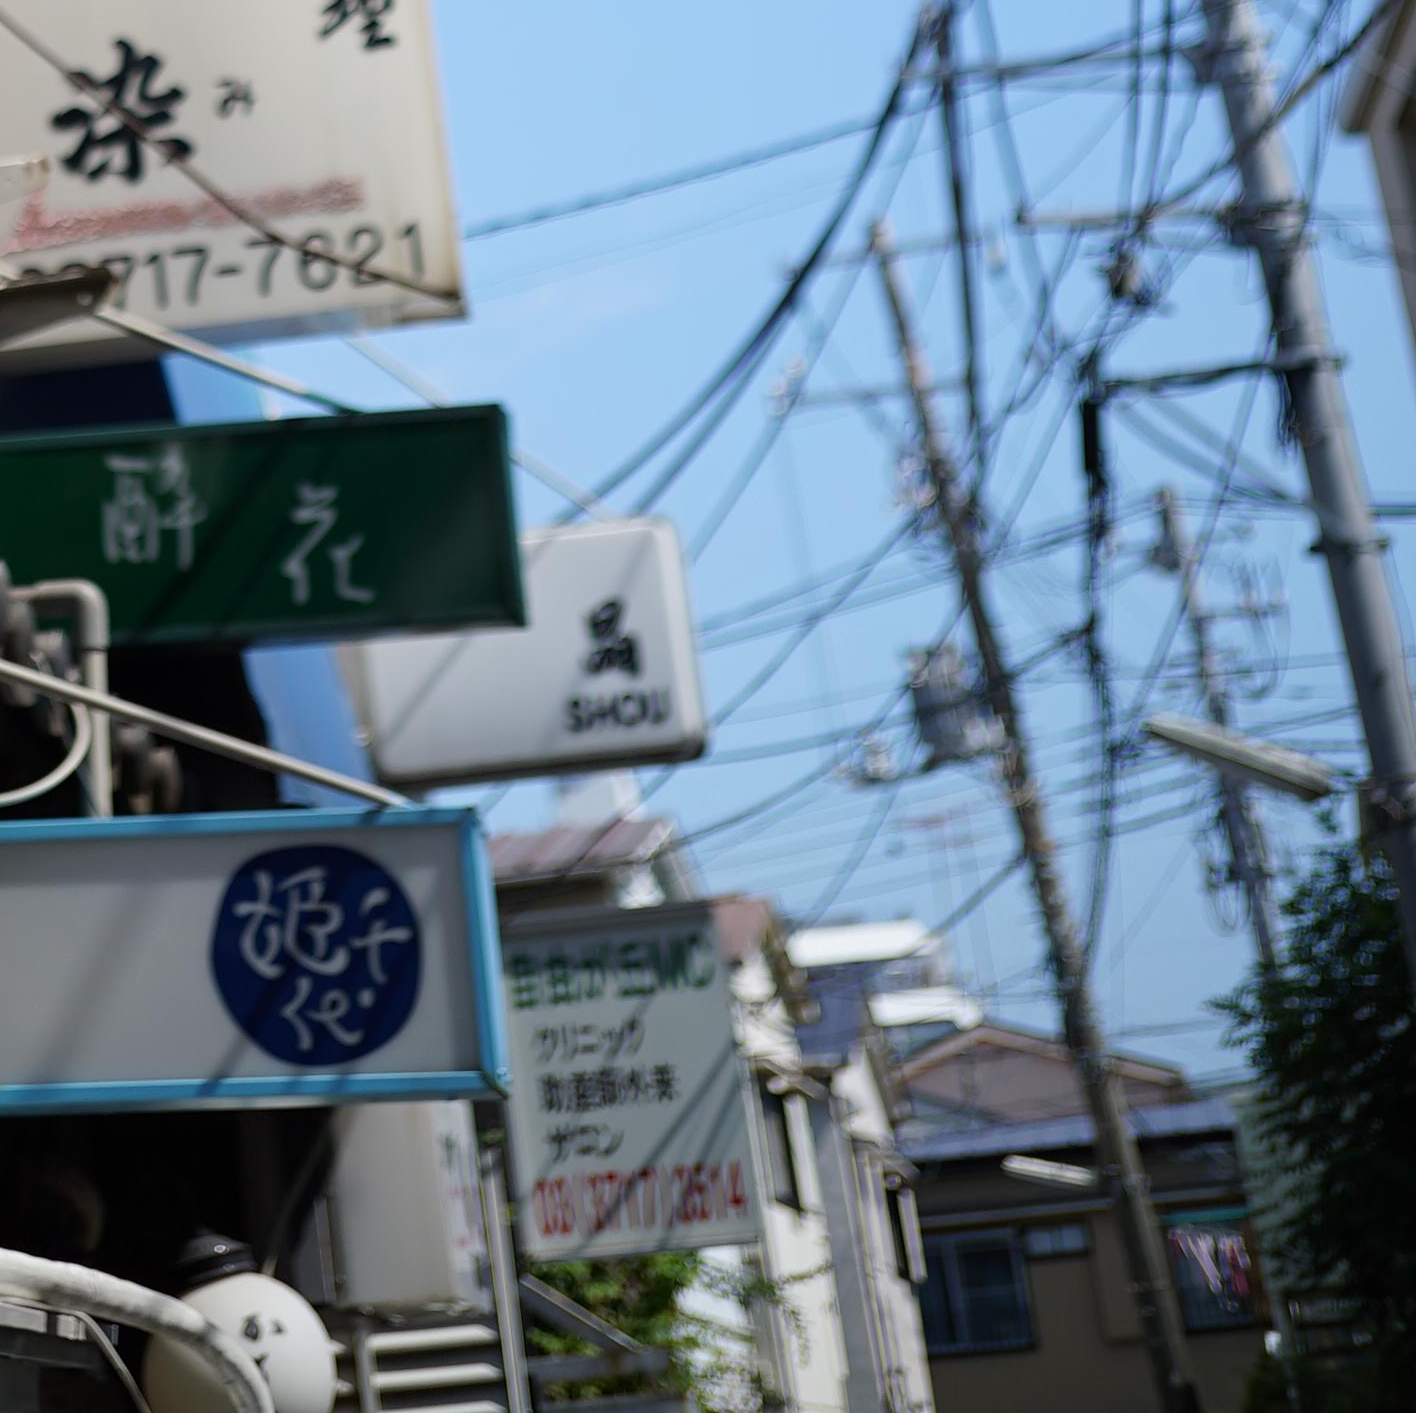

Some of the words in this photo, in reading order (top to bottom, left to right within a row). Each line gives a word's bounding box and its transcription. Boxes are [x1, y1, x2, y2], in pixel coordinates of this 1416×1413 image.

[20, 221, 426, 311] 717-7621
[533, 1017, 645, 1063] クリニック
